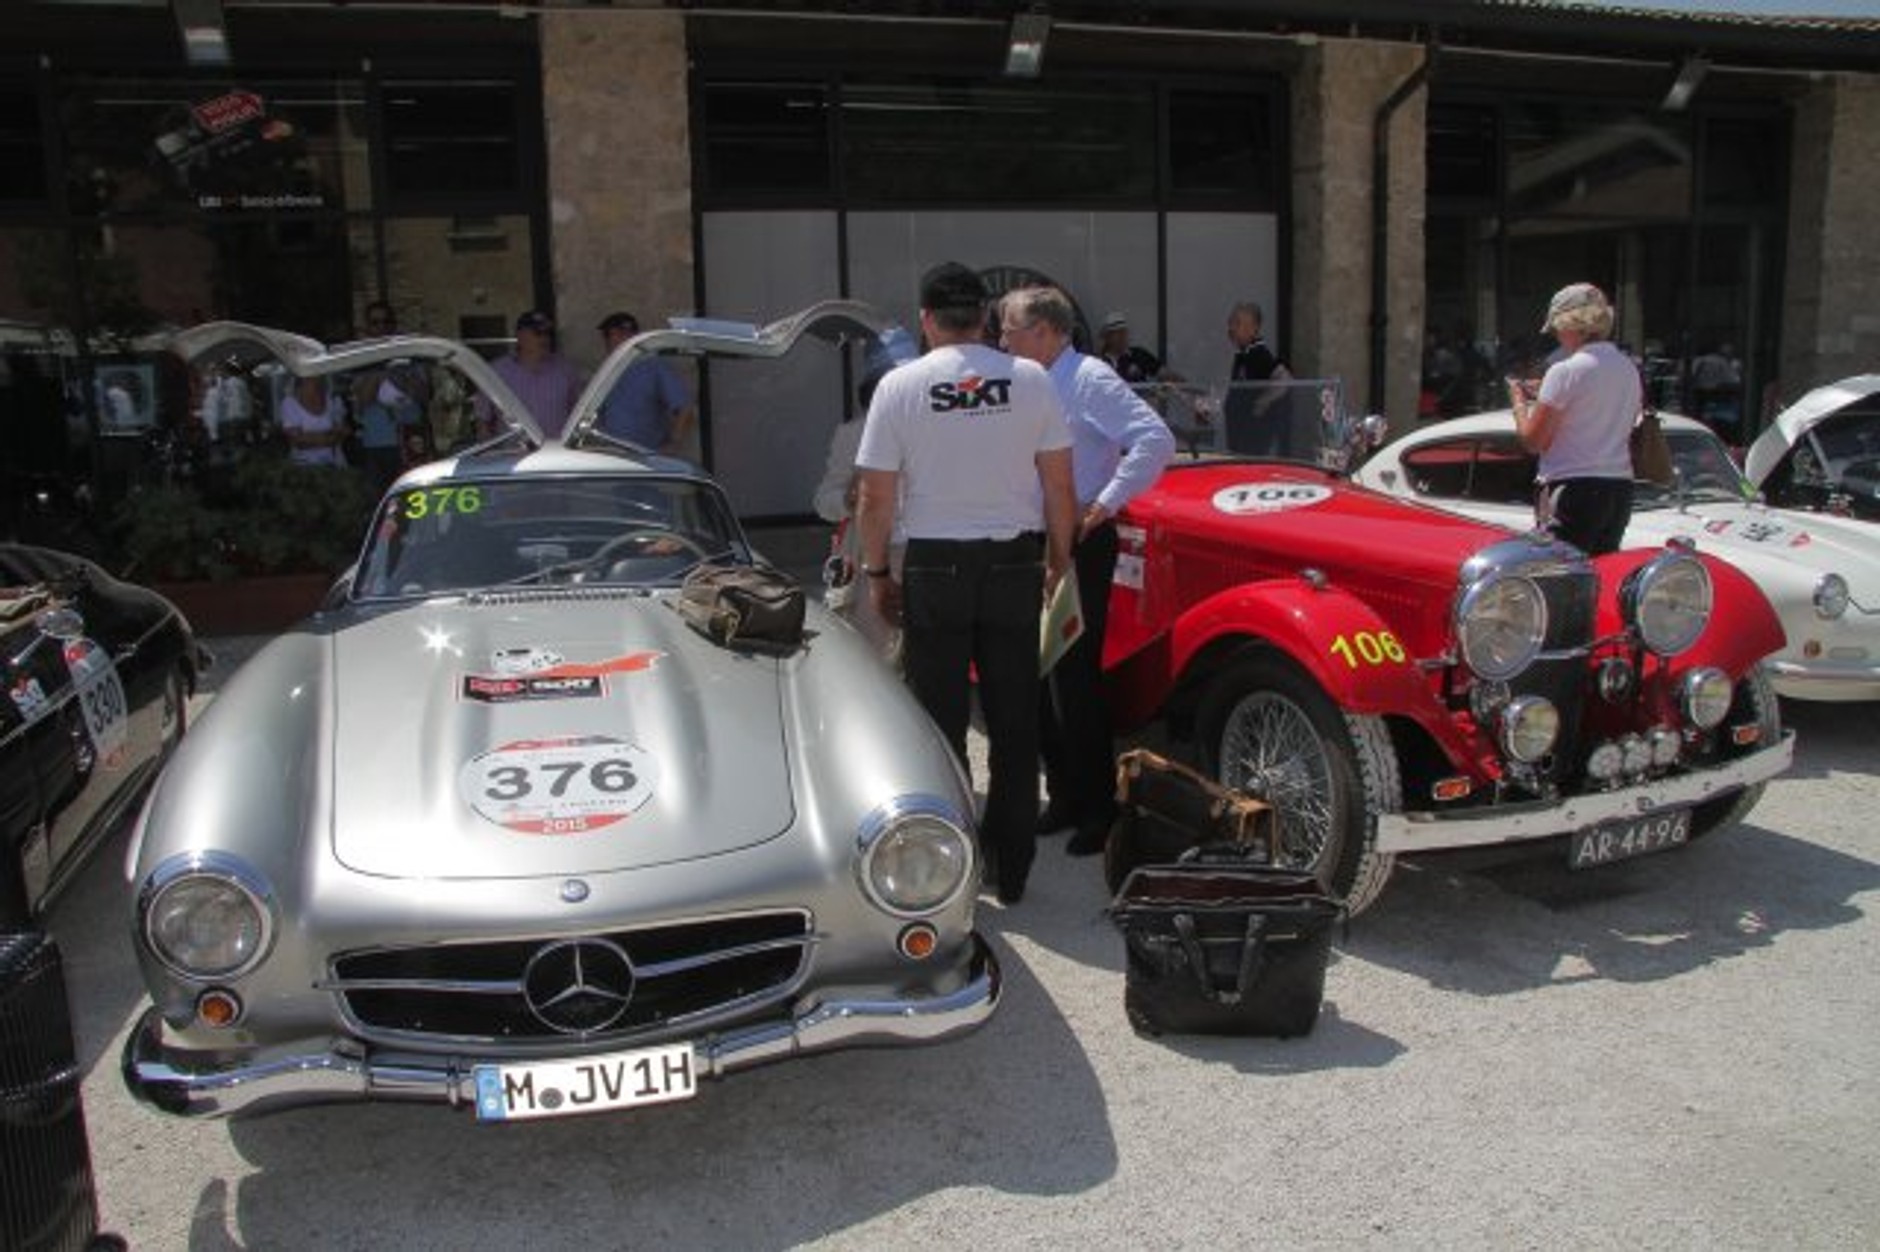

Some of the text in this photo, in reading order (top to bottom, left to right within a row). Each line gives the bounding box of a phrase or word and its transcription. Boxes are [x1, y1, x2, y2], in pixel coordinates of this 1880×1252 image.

[405, 486, 480, 518] 376
[1229, 487, 1316, 505] 106
[1330, 631, 1406, 668] 106
[485, 759, 638, 800] 376
[543, 818, 588, 833] 2015
[570, 1052, 692, 1104] JV1H
